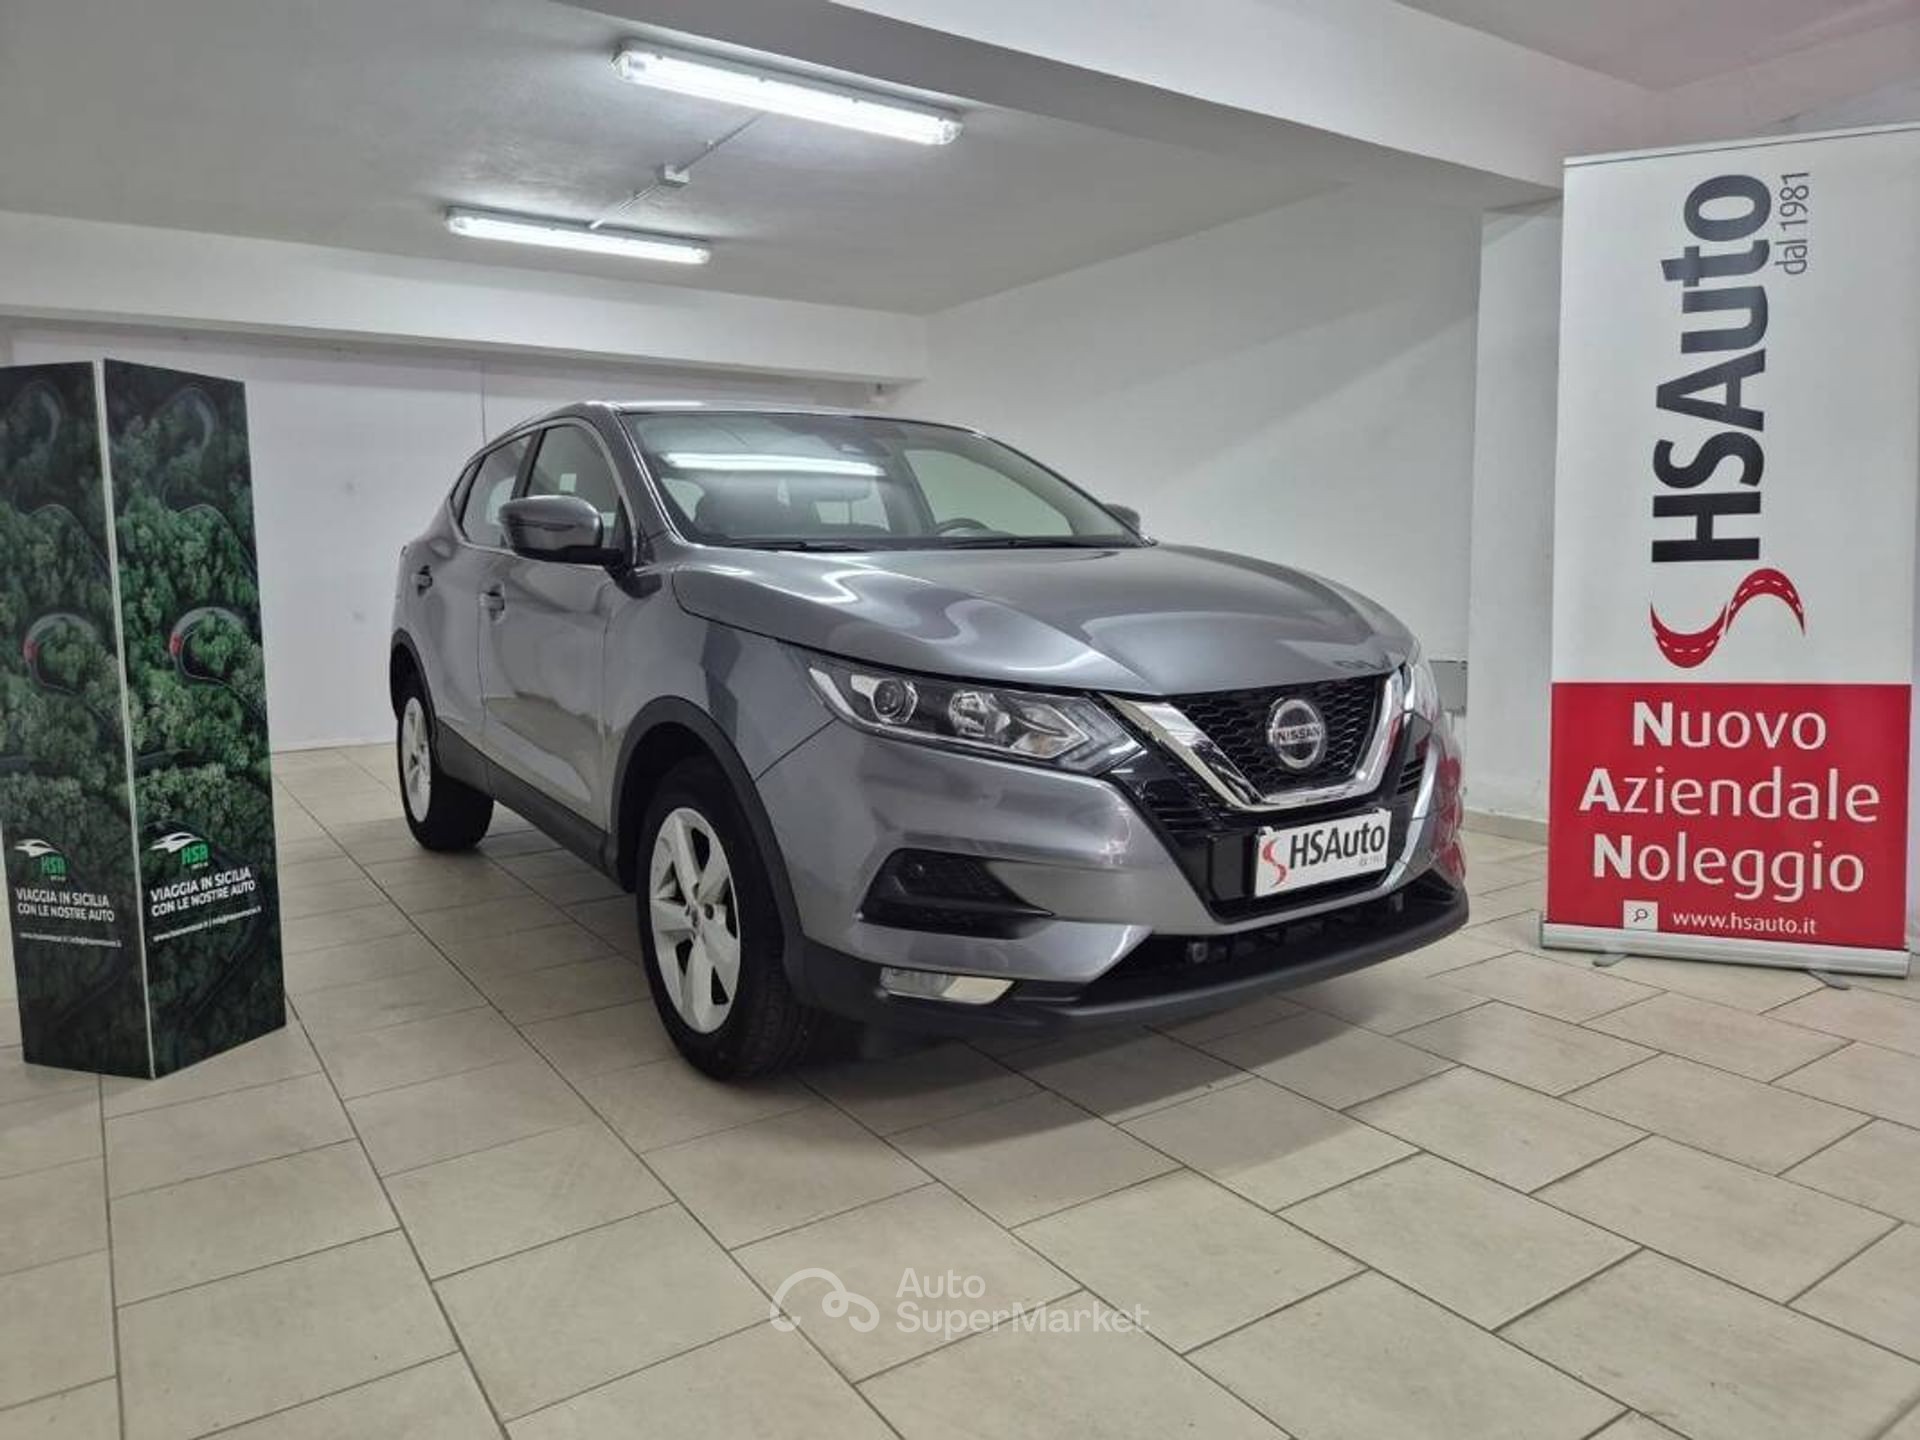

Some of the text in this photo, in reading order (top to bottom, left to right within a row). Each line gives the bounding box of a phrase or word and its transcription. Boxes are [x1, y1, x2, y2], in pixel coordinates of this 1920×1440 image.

[1773, 172, 1810, 276] dal 1981
[1651, 174, 1772, 563] HSAuto
[1276, 726, 1322, 744] NISSAN
[1632, 700, 1827, 750] Nuovo
[1578, 765, 1880, 823] Aziendale
[1289, 822, 1386, 869] HSAuto
[150, 866, 251, 902] VIAGGIA IN SICILIA
[1593, 831, 1865, 903] Noleggio
[15, 887, 110, 907] VIAGGIA IN SICILIA
[17, 902, 115, 922] CON LE NOSTRE AUTO
[151, 880, 256, 917] CON LE NOSTRE AUTO
[1672, 910, 1817, 936] www.hsauto.it
